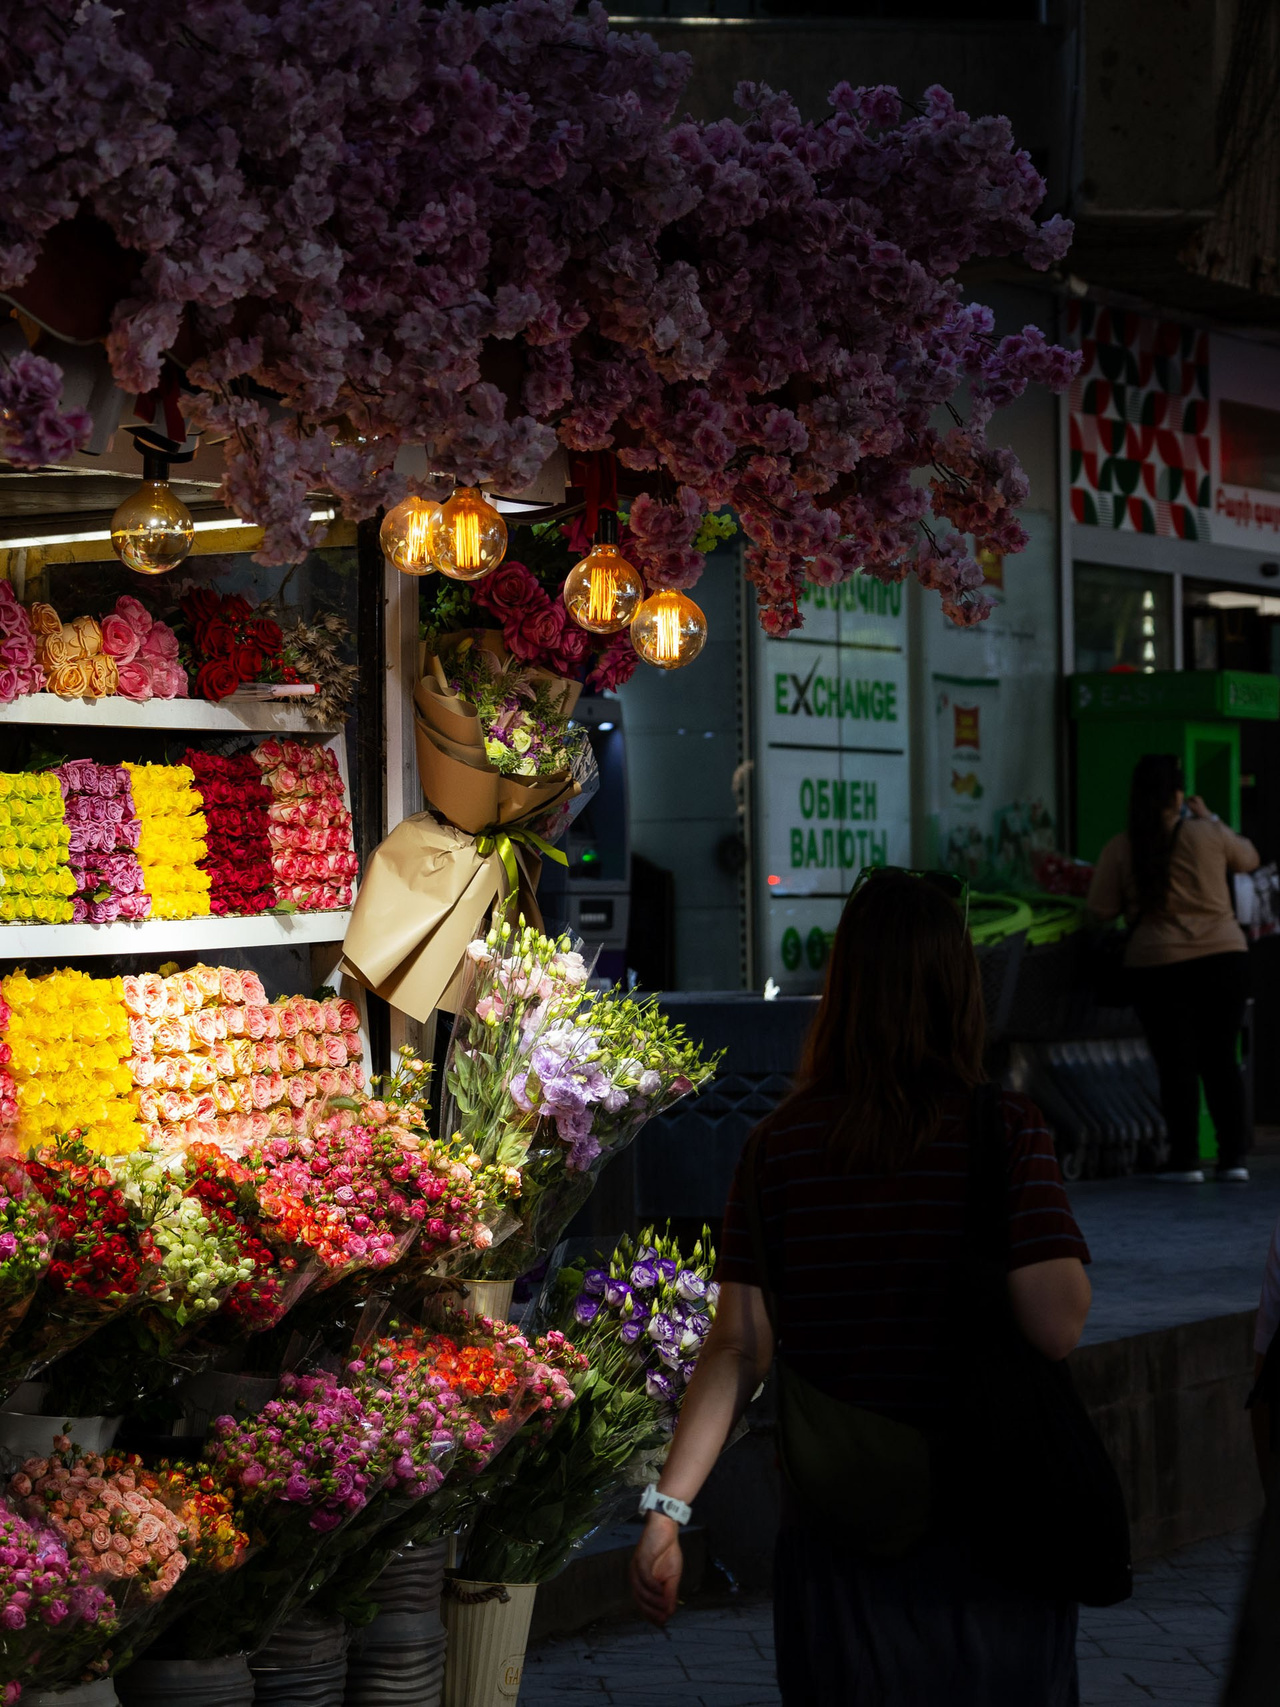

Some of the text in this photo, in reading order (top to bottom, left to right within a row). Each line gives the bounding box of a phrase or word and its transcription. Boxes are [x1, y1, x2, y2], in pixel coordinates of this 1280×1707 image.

[776, 655, 897, 721] EXCHANGE
[800, 778, 876, 820] ОБМЕН
[791, 828, 887, 868] ВАЛЮТЫ
